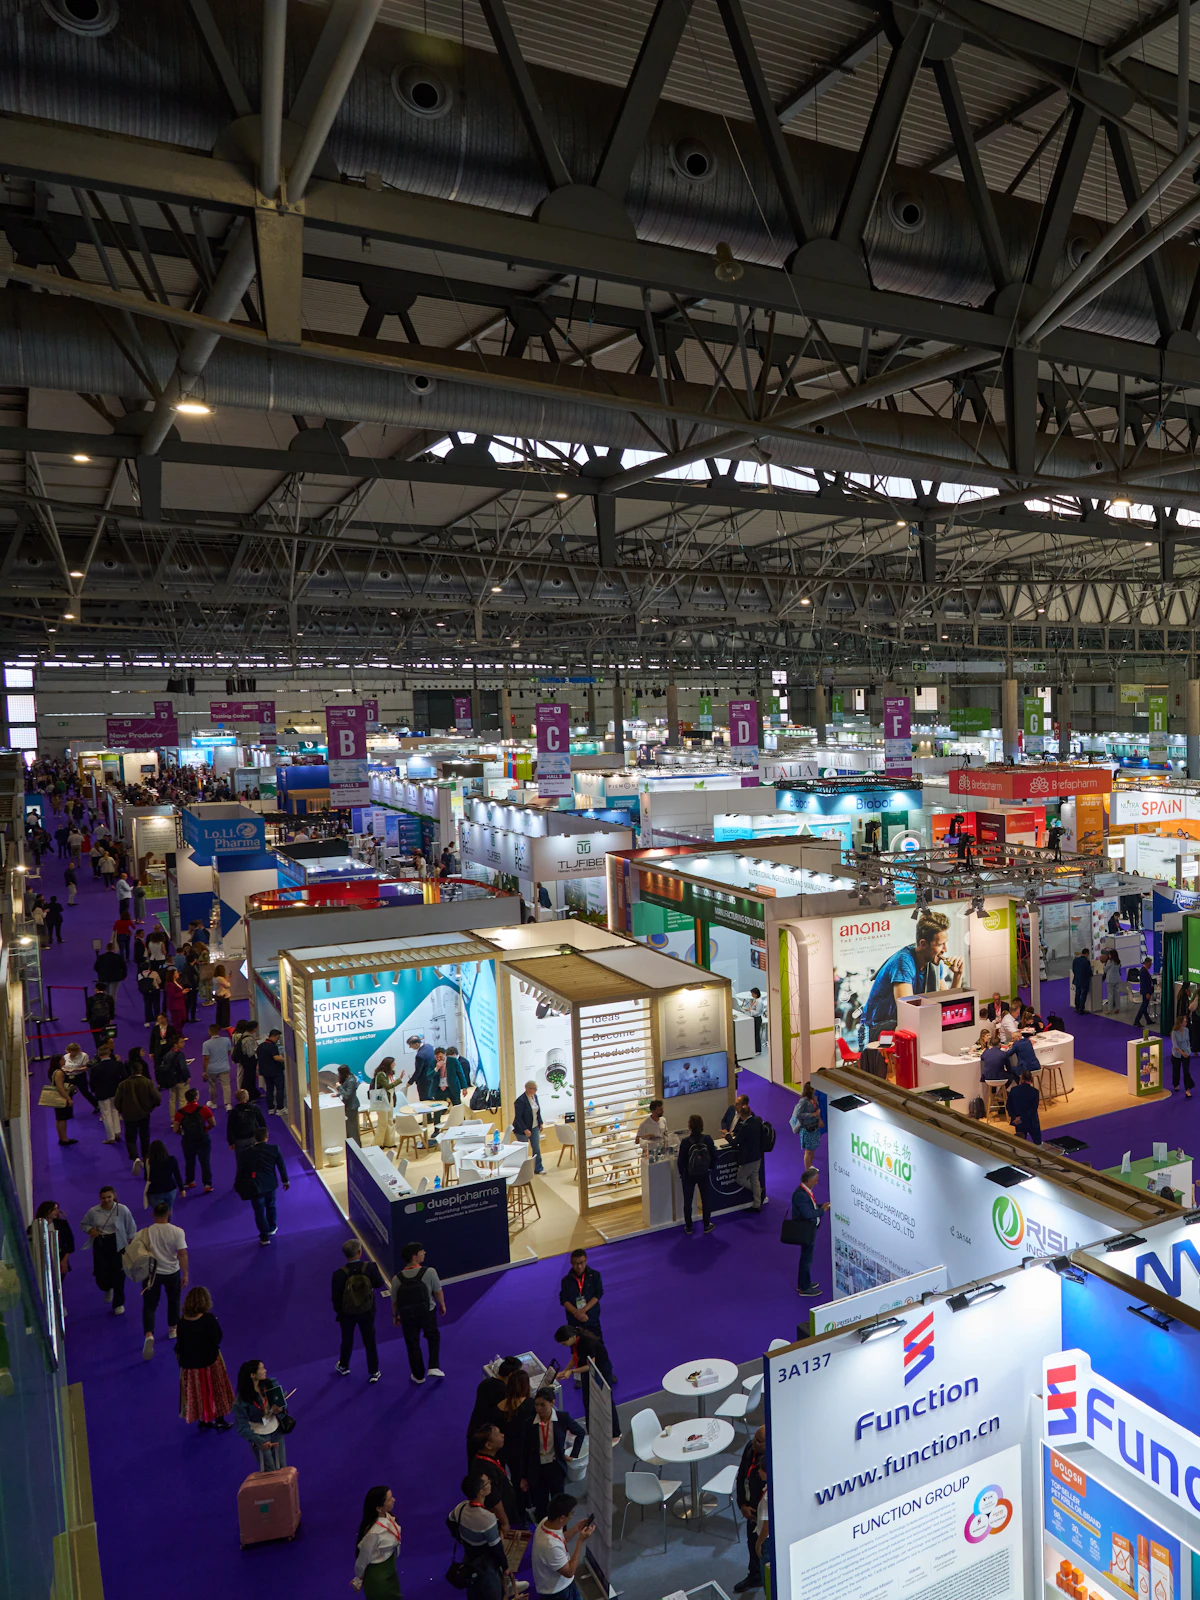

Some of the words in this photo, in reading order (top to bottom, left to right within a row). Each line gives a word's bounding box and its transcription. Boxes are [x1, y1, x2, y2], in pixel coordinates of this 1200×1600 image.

[263, 711, 271, 723] C
[367, 709, 374, 721] D
[459, 707, 465, 718] F
[1154, 712, 1162, 730] H
[738, 721, 750, 744] D
[893, 716, 903, 737] F
[1030, 713, 1038, 734] G
[339, 730, 356, 756] B
[547, 726, 560, 750] C
[763, 763, 813, 778] ITALIA
[830, 755, 852, 768] ITALIA
[1052, 778, 1098, 791] Brefapharm
[856, 797, 895, 810] Biobor
[215, 838, 260, 849] Pharma
[840, 919, 890, 937] anona
[313, 995, 387, 1012] NGINEERING
[314, 1008, 375, 1023] TURNKEY
[314, 1019, 374, 1035] OLUTIONS
[427, 1186, 500, 1210] duepipharma
[850, 1184, 884, 1209] GUANGZHOU
[883, 1203, 916, 1227] HARWORLD
[853, 1197, 864, 1210] LIFE
[865, 1203, 892, 1226] SCIENCES
[903, 1226, 915, 1239] LTD
[778, 1353, 832, 1383] 3A137
[855, 1376, 979, 1441] Function
[815, 1414, 1001, 1506] www.function.cn
[1054, 1458, 1083, 1486] DOLOSH
[852, 1497, 922, 1539] FUNCTION
[925, 1475, 970, 1506] GROUP
